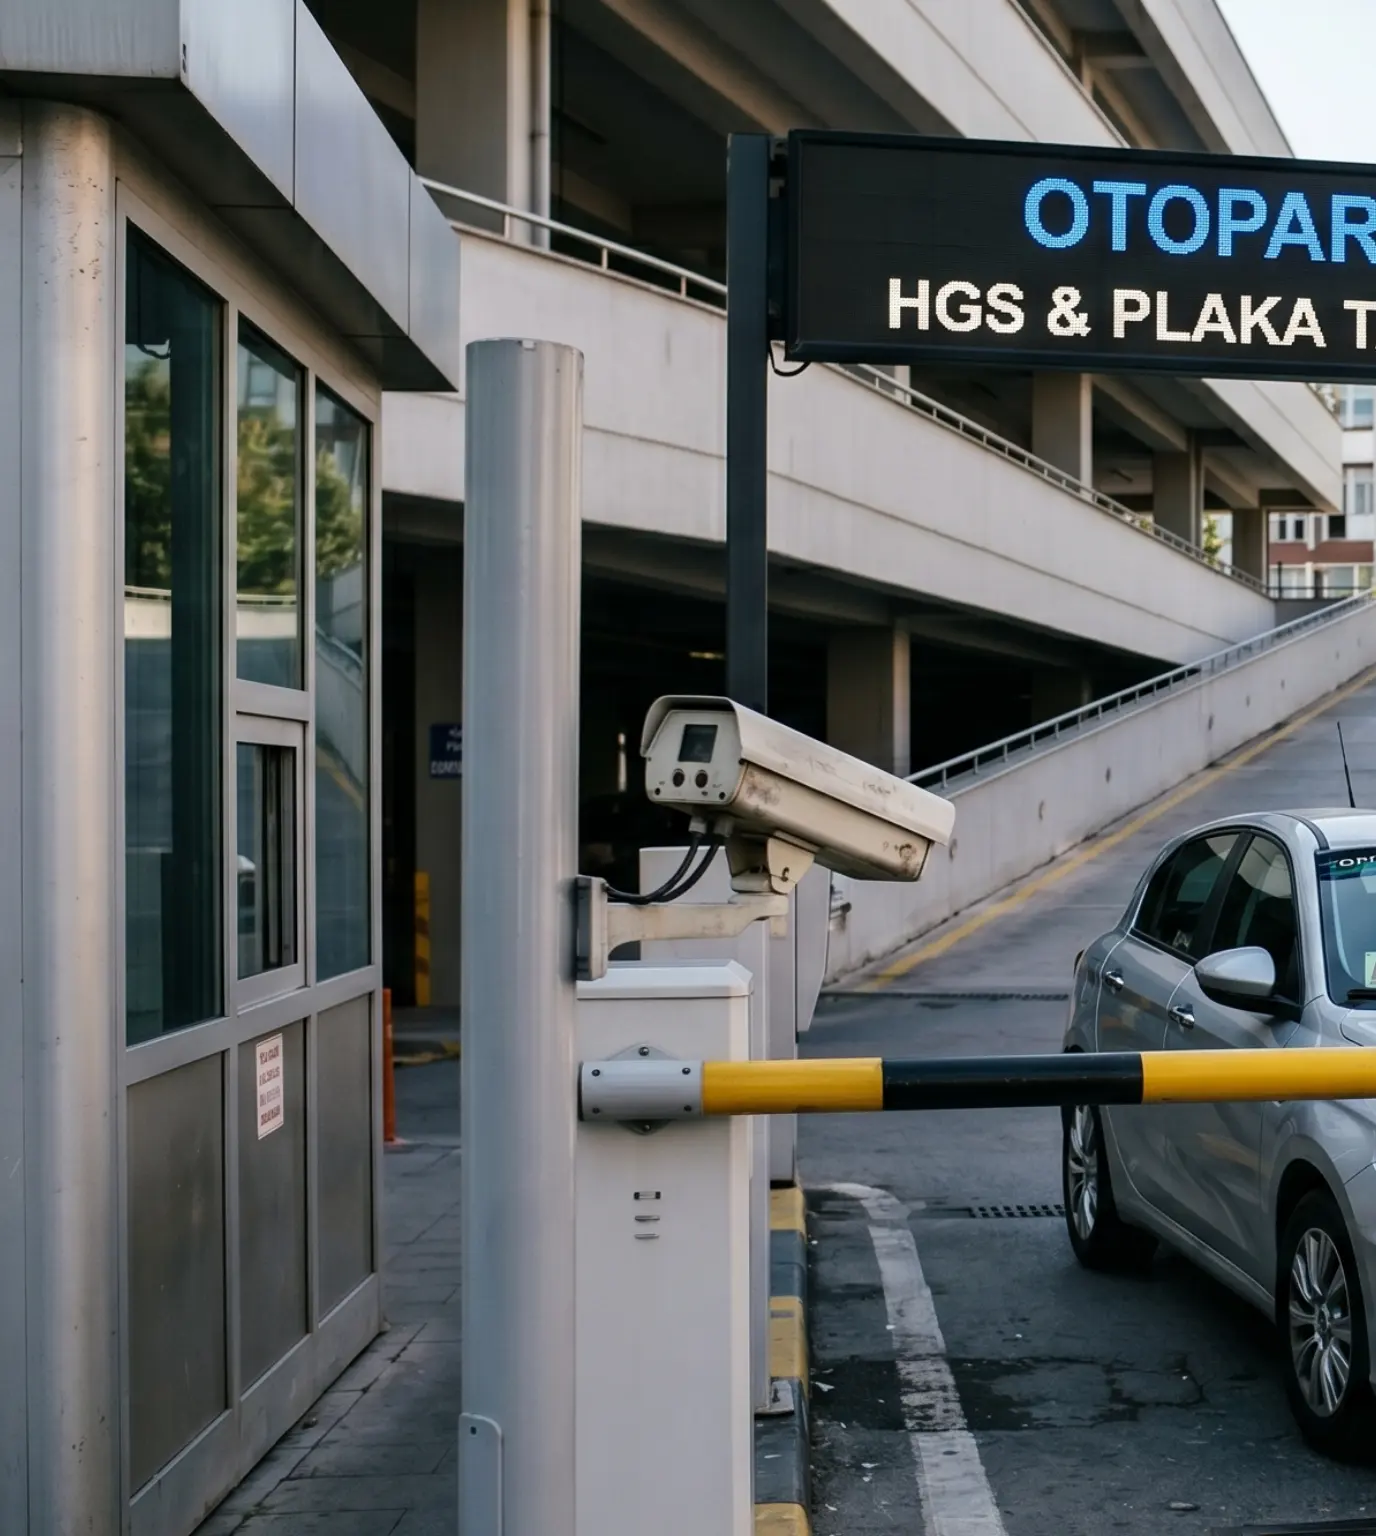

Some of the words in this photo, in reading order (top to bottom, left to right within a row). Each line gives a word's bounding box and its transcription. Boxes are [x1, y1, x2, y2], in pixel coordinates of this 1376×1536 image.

[888, 277, 1025, 334] HGS
[1046, 285, 1092, 337] &
[1112, 288, 1327, 348] PLAKA
